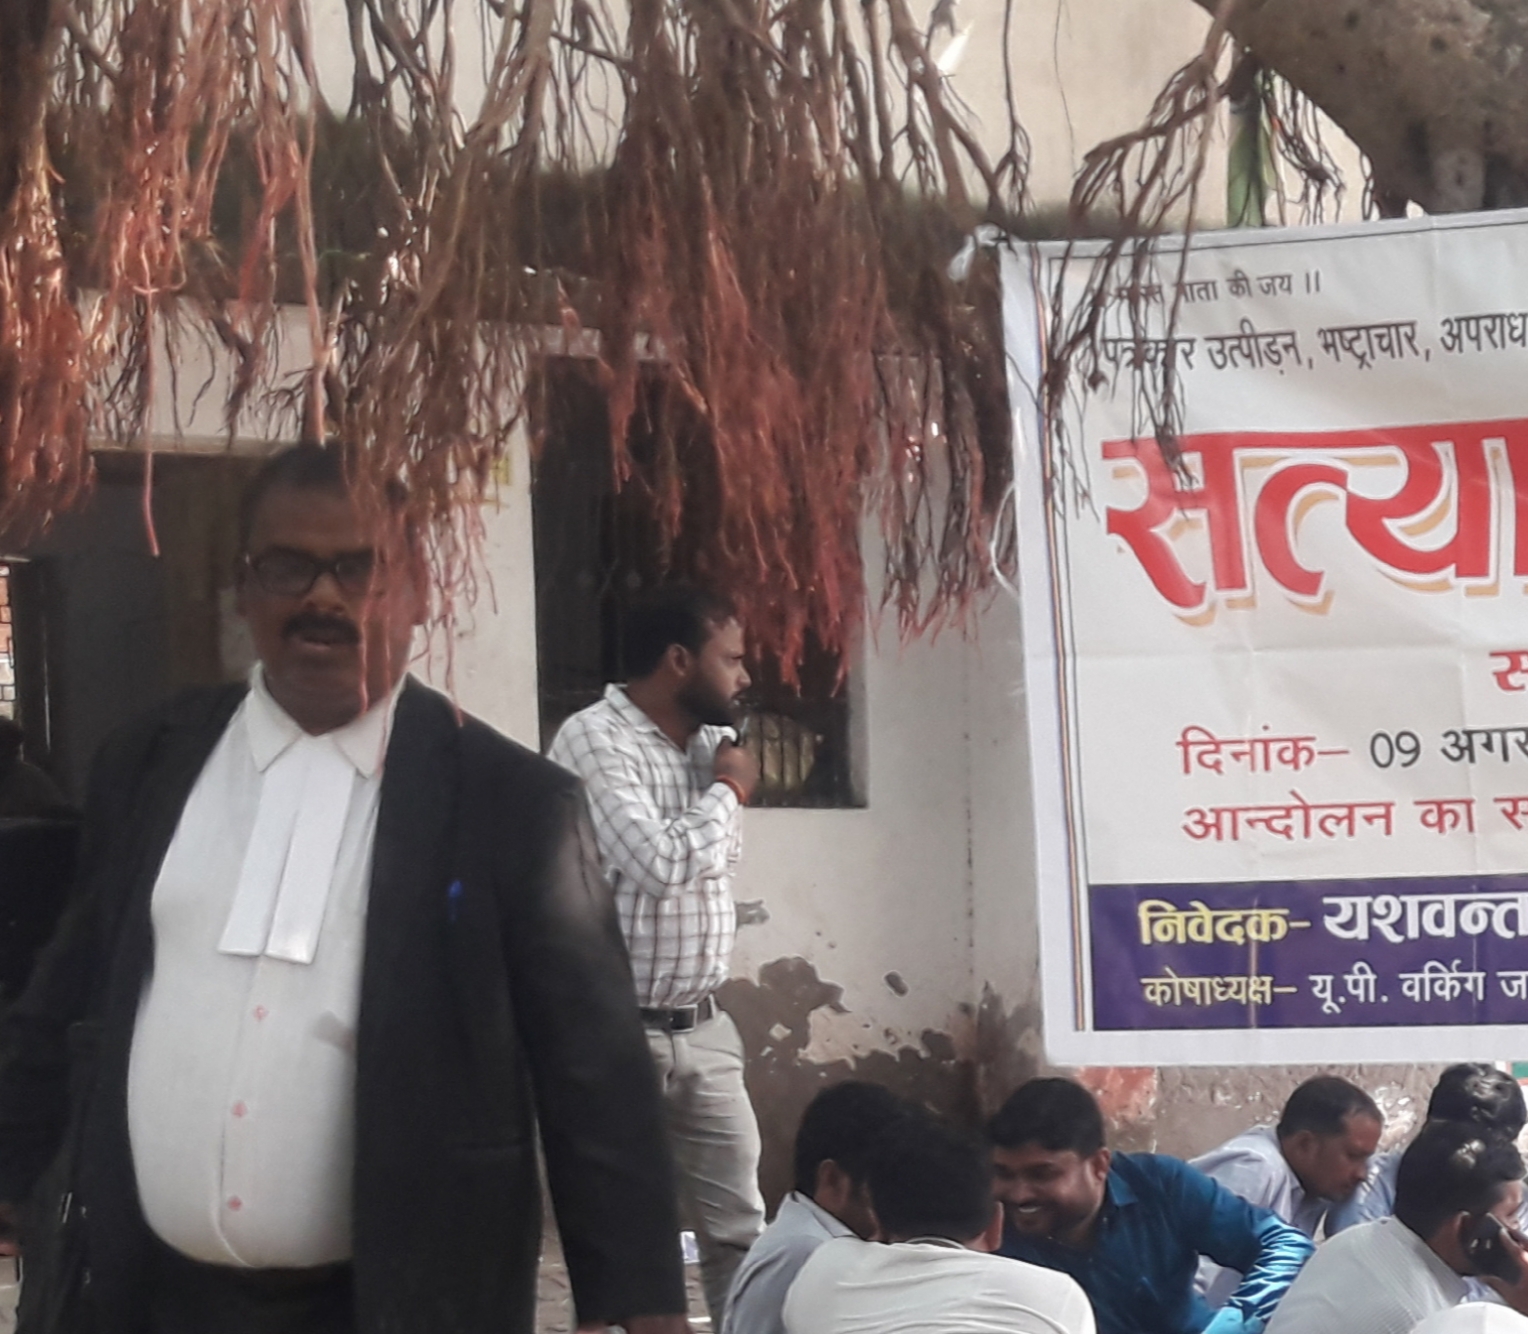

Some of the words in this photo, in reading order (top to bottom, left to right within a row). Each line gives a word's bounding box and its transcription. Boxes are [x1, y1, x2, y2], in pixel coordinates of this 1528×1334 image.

[1227, 269, 1252, 298] की
[1257, 274, 1292, 297] जय
[1370, 732, 1421, 769] 09
[1181, 789, 1394, 841] आन्दोलन
[1414, 798, 1475, 834] का
[1308, 962, 1389, 1013] यू.पी.
[1399, 960, 1486, 1003] वर्किंग
